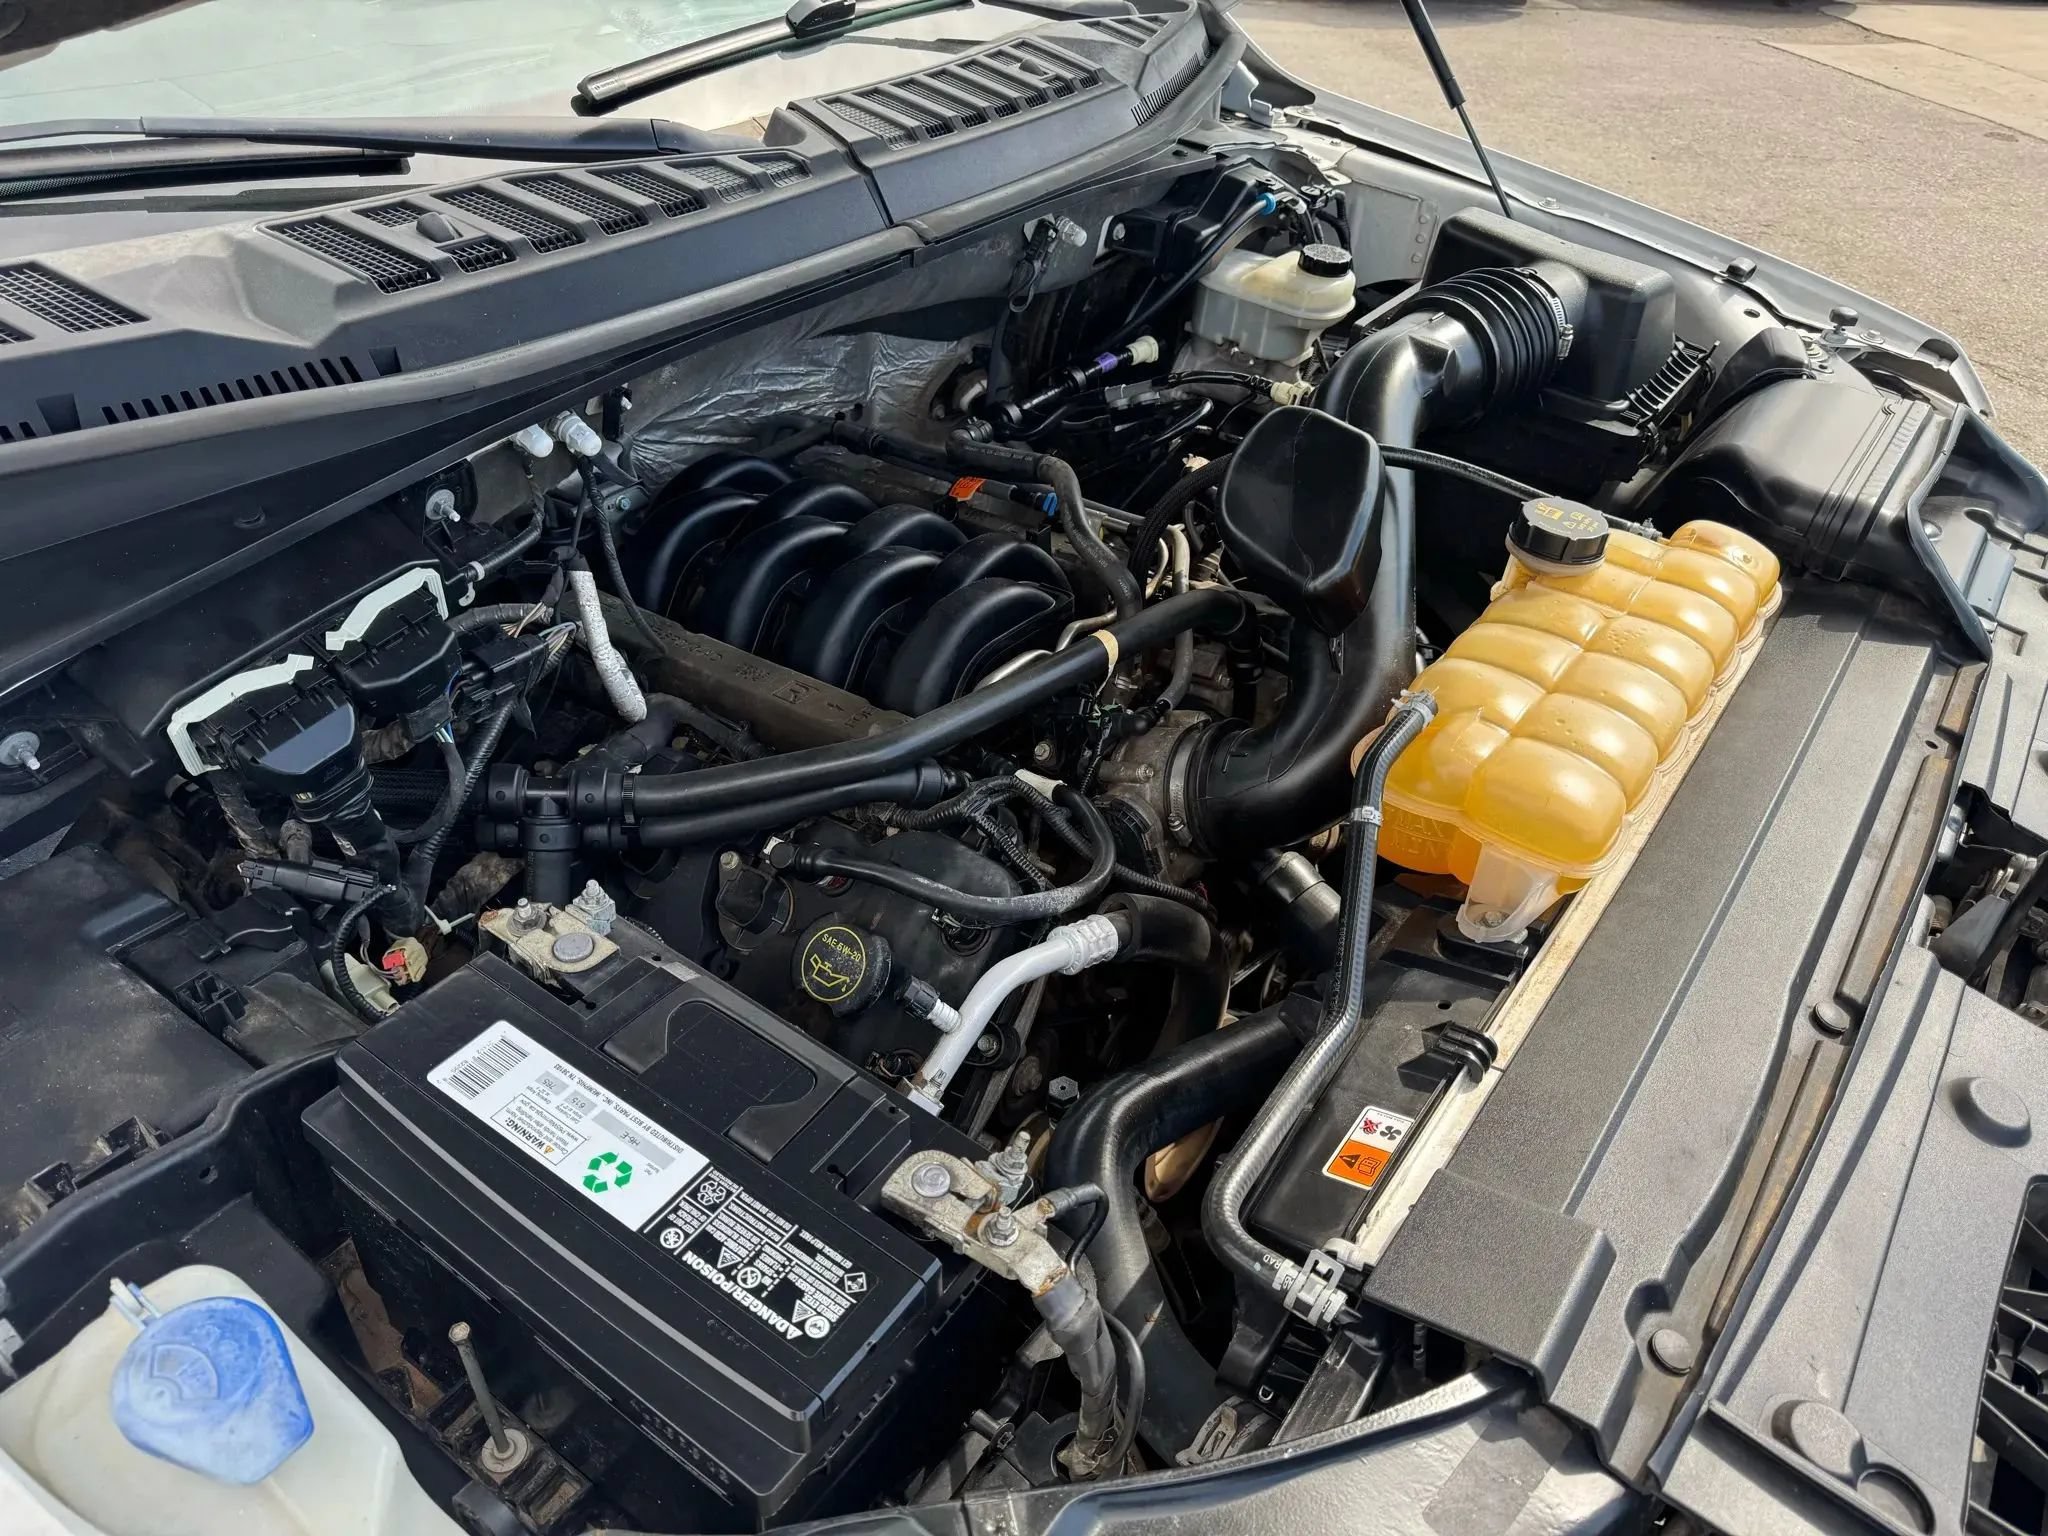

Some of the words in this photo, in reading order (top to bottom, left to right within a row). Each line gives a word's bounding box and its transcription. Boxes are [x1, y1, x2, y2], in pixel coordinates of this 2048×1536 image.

[822, 934, 837, 947] SAE
[837, 943, 861, 961] 5W-20
[542, 1078, 557, 1090] 765
[576, 1077, 601, 1097] MEMPHIS,
[572, 1097, 586, 1109] 615
[613, 1102, 631, 1118] PARTS,
[515, 1106, 534, 1121] handling.
[520, 1099, 579, 1142] www.P65Warnings.ca.gov
[629, 1115, 644, 1126] BEST
[517, 1116, 545, 1138] Reproductive
[533, 1119, 544, 1128] after
[505, 1117, 545, 1149] WARNING:
[543, 1126, 556, 1138] hands
[543, 1135, 553, 1143] and
[620, 1131, 641, 1146] H6-E
[552, 1141, 569, 1155] Cancer
[556, 1135, 569, 1146] Wash
[649, 1129, 684, 1154] DISTRIBUTED
[667, 1213, 677, 1221] OF
[672, 1215, 686, 1227] OUT
[675, 1207, 694, 1223] REACH
[688, 1217, 702, 1229] THE
[696, 1212, 708, 1223] OF
[680, 1221, 696, 1235] KEEP
[710, 1217, 741, 1241] BLINDNESS
[711, 1229, 728, 1243] ACID
[731, 1222, 754, 1240] SEVERE
[762, 1226, 782, 1243] READ
[722, 1236, 750, 1258] SULFURIC
[734, 1234, 756, 1252] CAUSE
[748, 1234, 761, 1245] OR
[751, 1257, 776, 1277] SPARKS
[757, 1251, 782, 1271] FLAMES
[1263, 1254, 1281, 1269] RAD
[682, 1250, 791, 1332] DANGER/POISON
[793, 1277, 817, 1296] GASES
[810, 1289, 846, 1317] EXPLOSIVE
[815, 1302, 840, 1323] SHIELD
